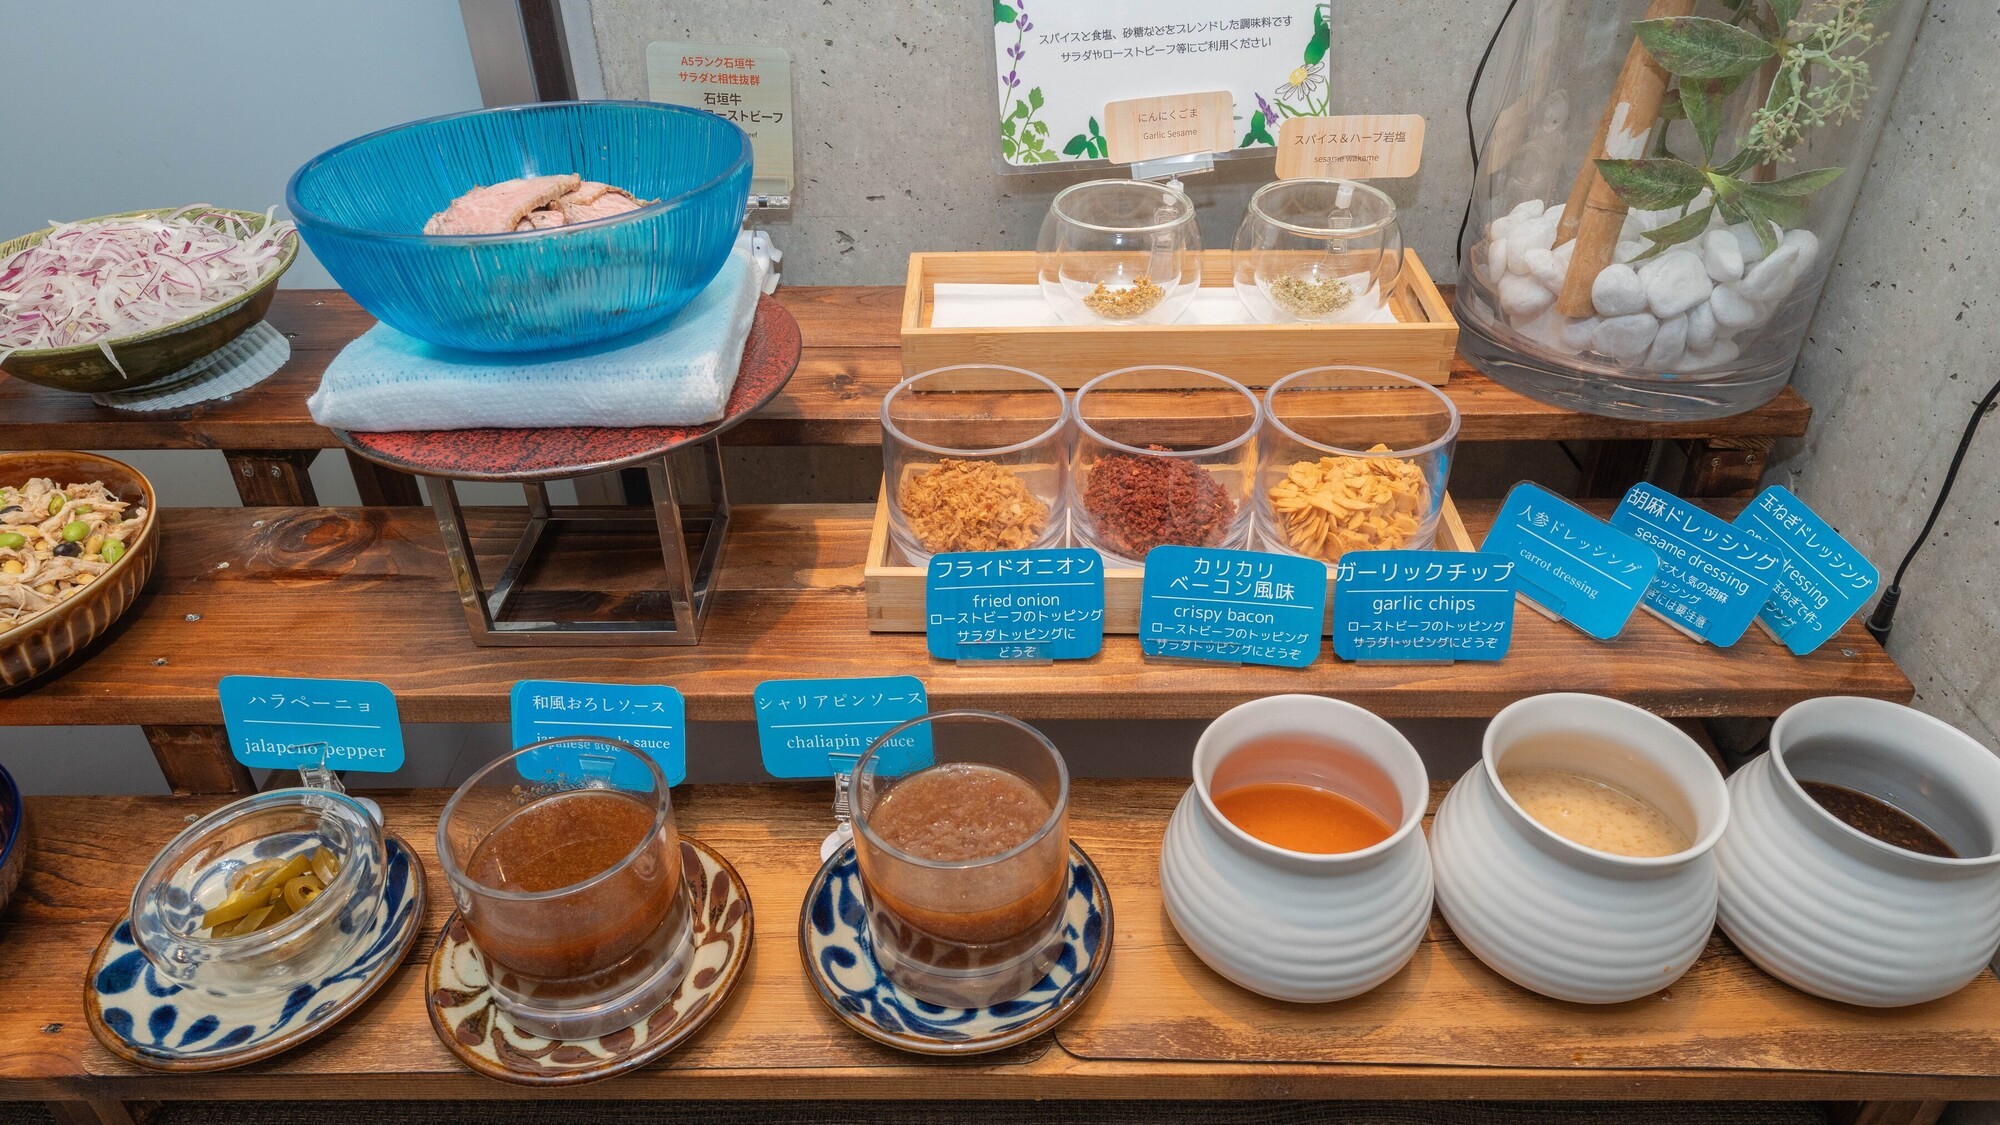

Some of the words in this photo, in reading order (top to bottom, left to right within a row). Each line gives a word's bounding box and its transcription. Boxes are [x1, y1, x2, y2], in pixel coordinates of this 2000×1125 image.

[1039, 15, 1293, 45] スパイスと食塩、砂糖などをブレンドした調味料です
[1060, 37, 1272, 62] サラダやローストビーフ等にご利用ください
[681, 56, 755, 70] A5ランク石垣牛
[678, 72, 760, 86] サラダと相性抜群
[703, 92, 742, 106] 石垣牛
[1138, 108, 1198, 123] にんにくごま
[1143, 132, 1166, 141] Garlic
[1167, 129, 1198, 138] Sesame
[1314, 155, 1344, 163] sesame
[1346, 153, 1380, 163] wakame
[1626, 487, 1779, 570] 胡麻ドレッシング
[1518, 505, 1643, 574] 人参ドレッシング
[1759, 493, 1872, 588] 玉ねぎドレッシング
[936, 557, 1094, 579] フライドオニオン
[1193, 557, 1274, 580] カリカリ
[1634, 526, 1686, 560] sesame
[1688, 555, 1750, 596] dressing
[1336, 561, 1515, 582] ガーリックチップ
[1519, 548, 1552, 571] carrot
[1552, 565, 1600, 599] dressing
[1170, 576, 1295, 601] ベーコン風味
[973, 594, 1012, 608] fried
[1017, 593, 1060, 606] onion
[1373, 595, 1423, 614] garlic
[1428, 596, 1476, 613] chips
[930, 609, 1103, 625] ローストビーフのトッピング
[1174, 605, 1223, 623] crispy
[1227, 608, 1275, 624] bacon
[957, 627, 1076, 642] サラダトッピングに
[1151, 622, 1309, 644] ローストビーフのトッピング
[1348, 620, 1506, 632] ローストビーフのトッピング
[1353, 636, 1499, 649] サラダトッピングにどうぞ
[999, 646, 1037, 659] どうぞ
[248, 693, 371, 713] ハラペーニョ
[533, 695, 665, 713] 和風おろしソース
[758, 693, 923, 711] シャリアピンソース
[634, 738, 671, 749] sauce
[787, 734, 860, 750] chaliapin
[324, 744, 387, 760] pepper
